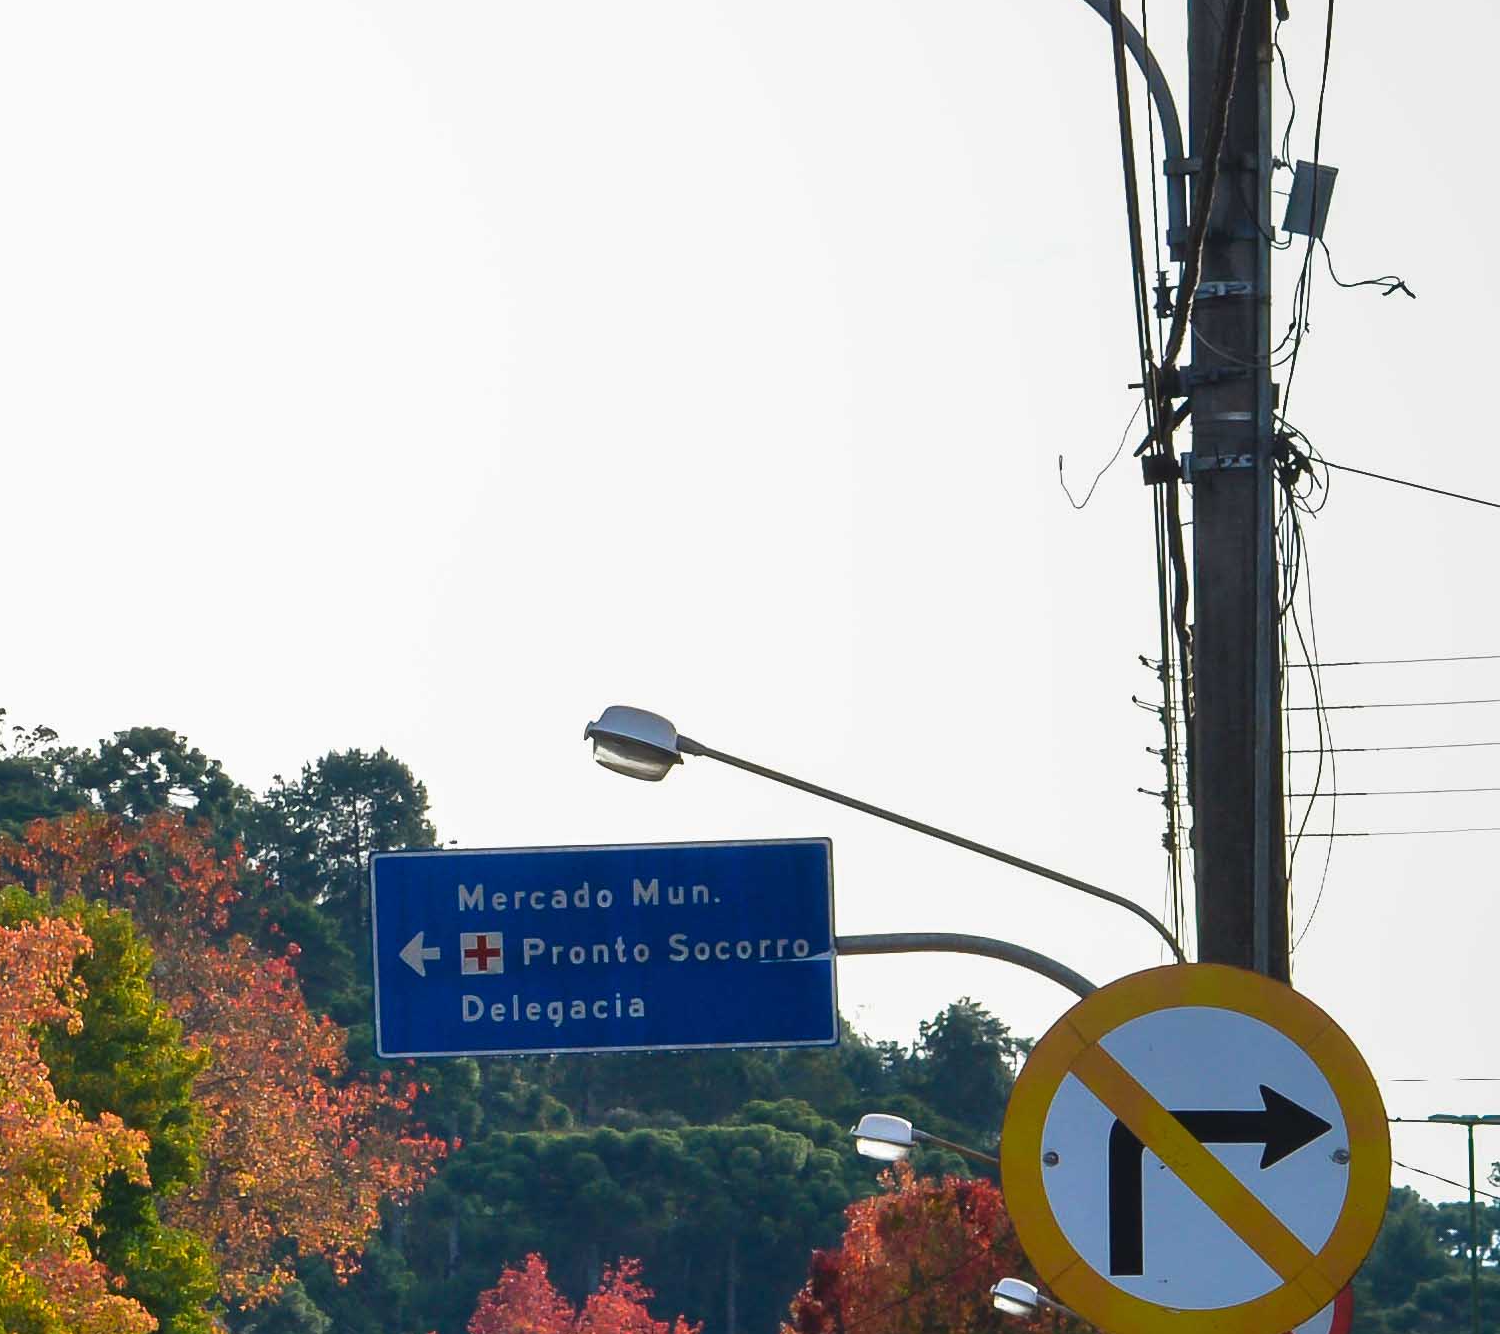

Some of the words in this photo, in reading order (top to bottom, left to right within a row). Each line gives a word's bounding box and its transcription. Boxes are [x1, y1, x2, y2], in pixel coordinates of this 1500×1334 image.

[458, 881, 613, 912] Mercado
[632, 877, 721, 907] Mun.
[522, 935, 651, 966] Pronto
[667, 933, 811, 963] Socorro
[461, 993, 646, 1028] Delegacia
